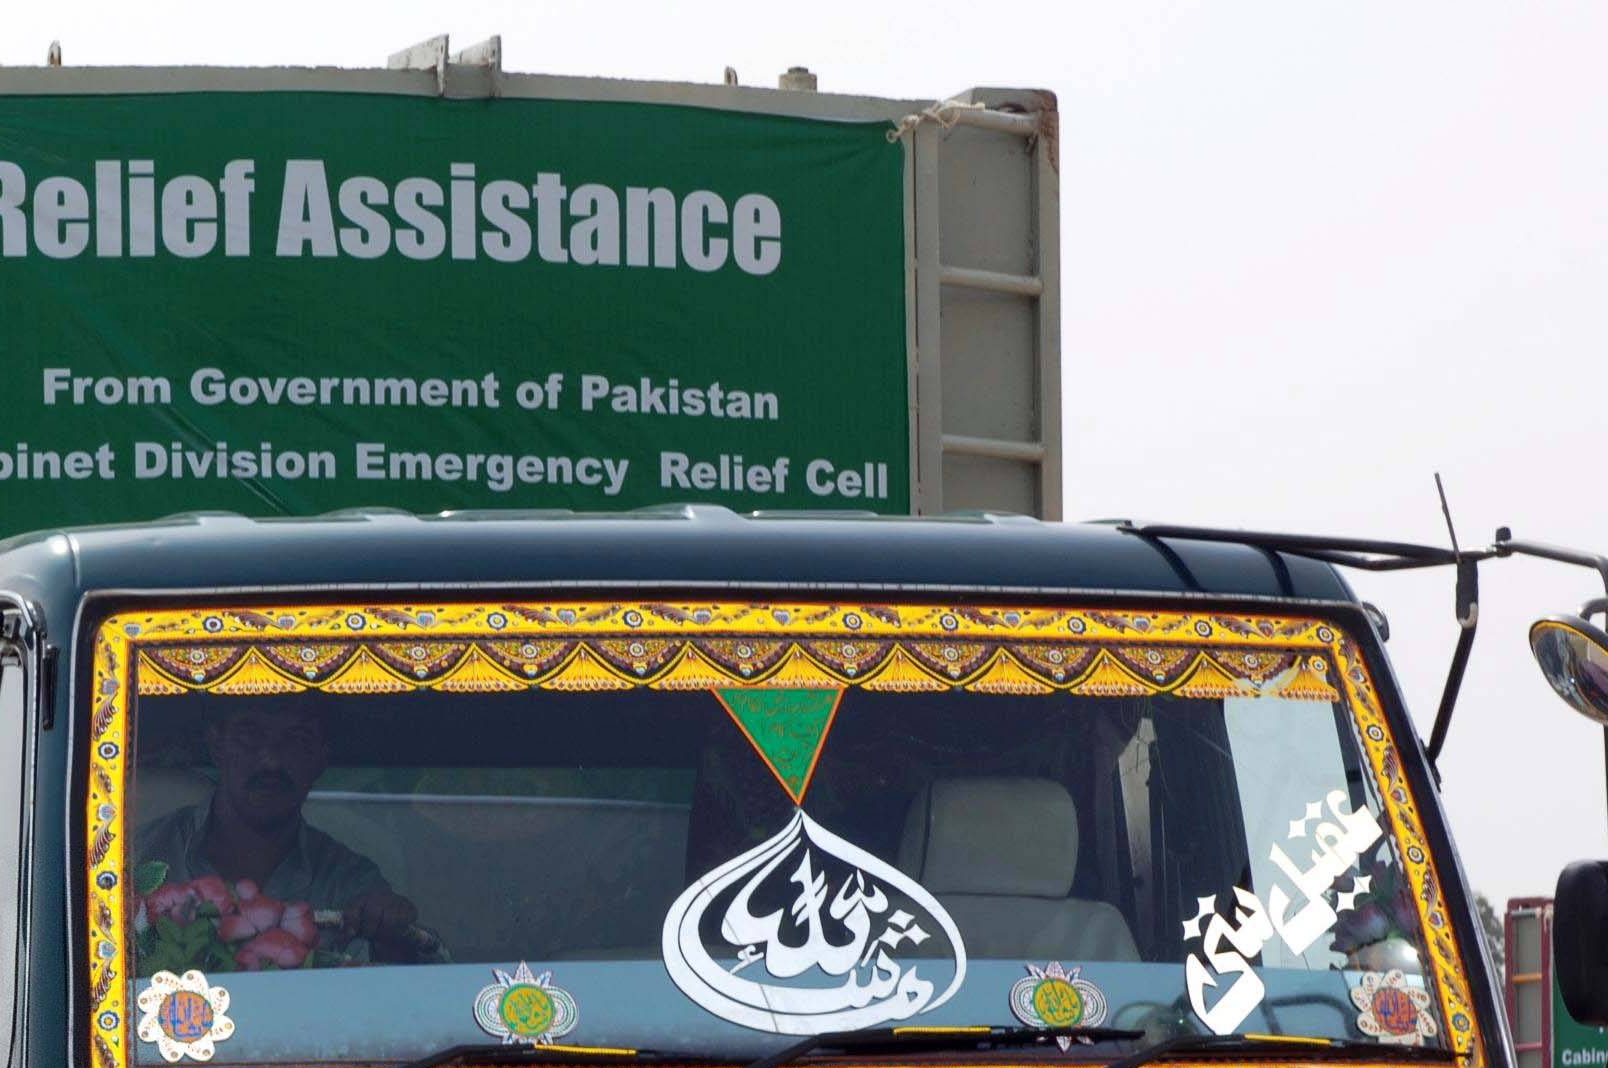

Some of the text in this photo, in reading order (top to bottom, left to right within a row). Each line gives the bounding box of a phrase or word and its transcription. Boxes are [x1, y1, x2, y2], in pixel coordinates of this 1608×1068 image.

[275, 159, 782, 276] Assistance
[43, 368, 779, 420] From Government of Pakistan
[135, 442, 336, 479] Division
[356, 442, 629, 496] Emergency
[660, 452, 790, 493] Relief
[806, 459, 888, 499] Cell
